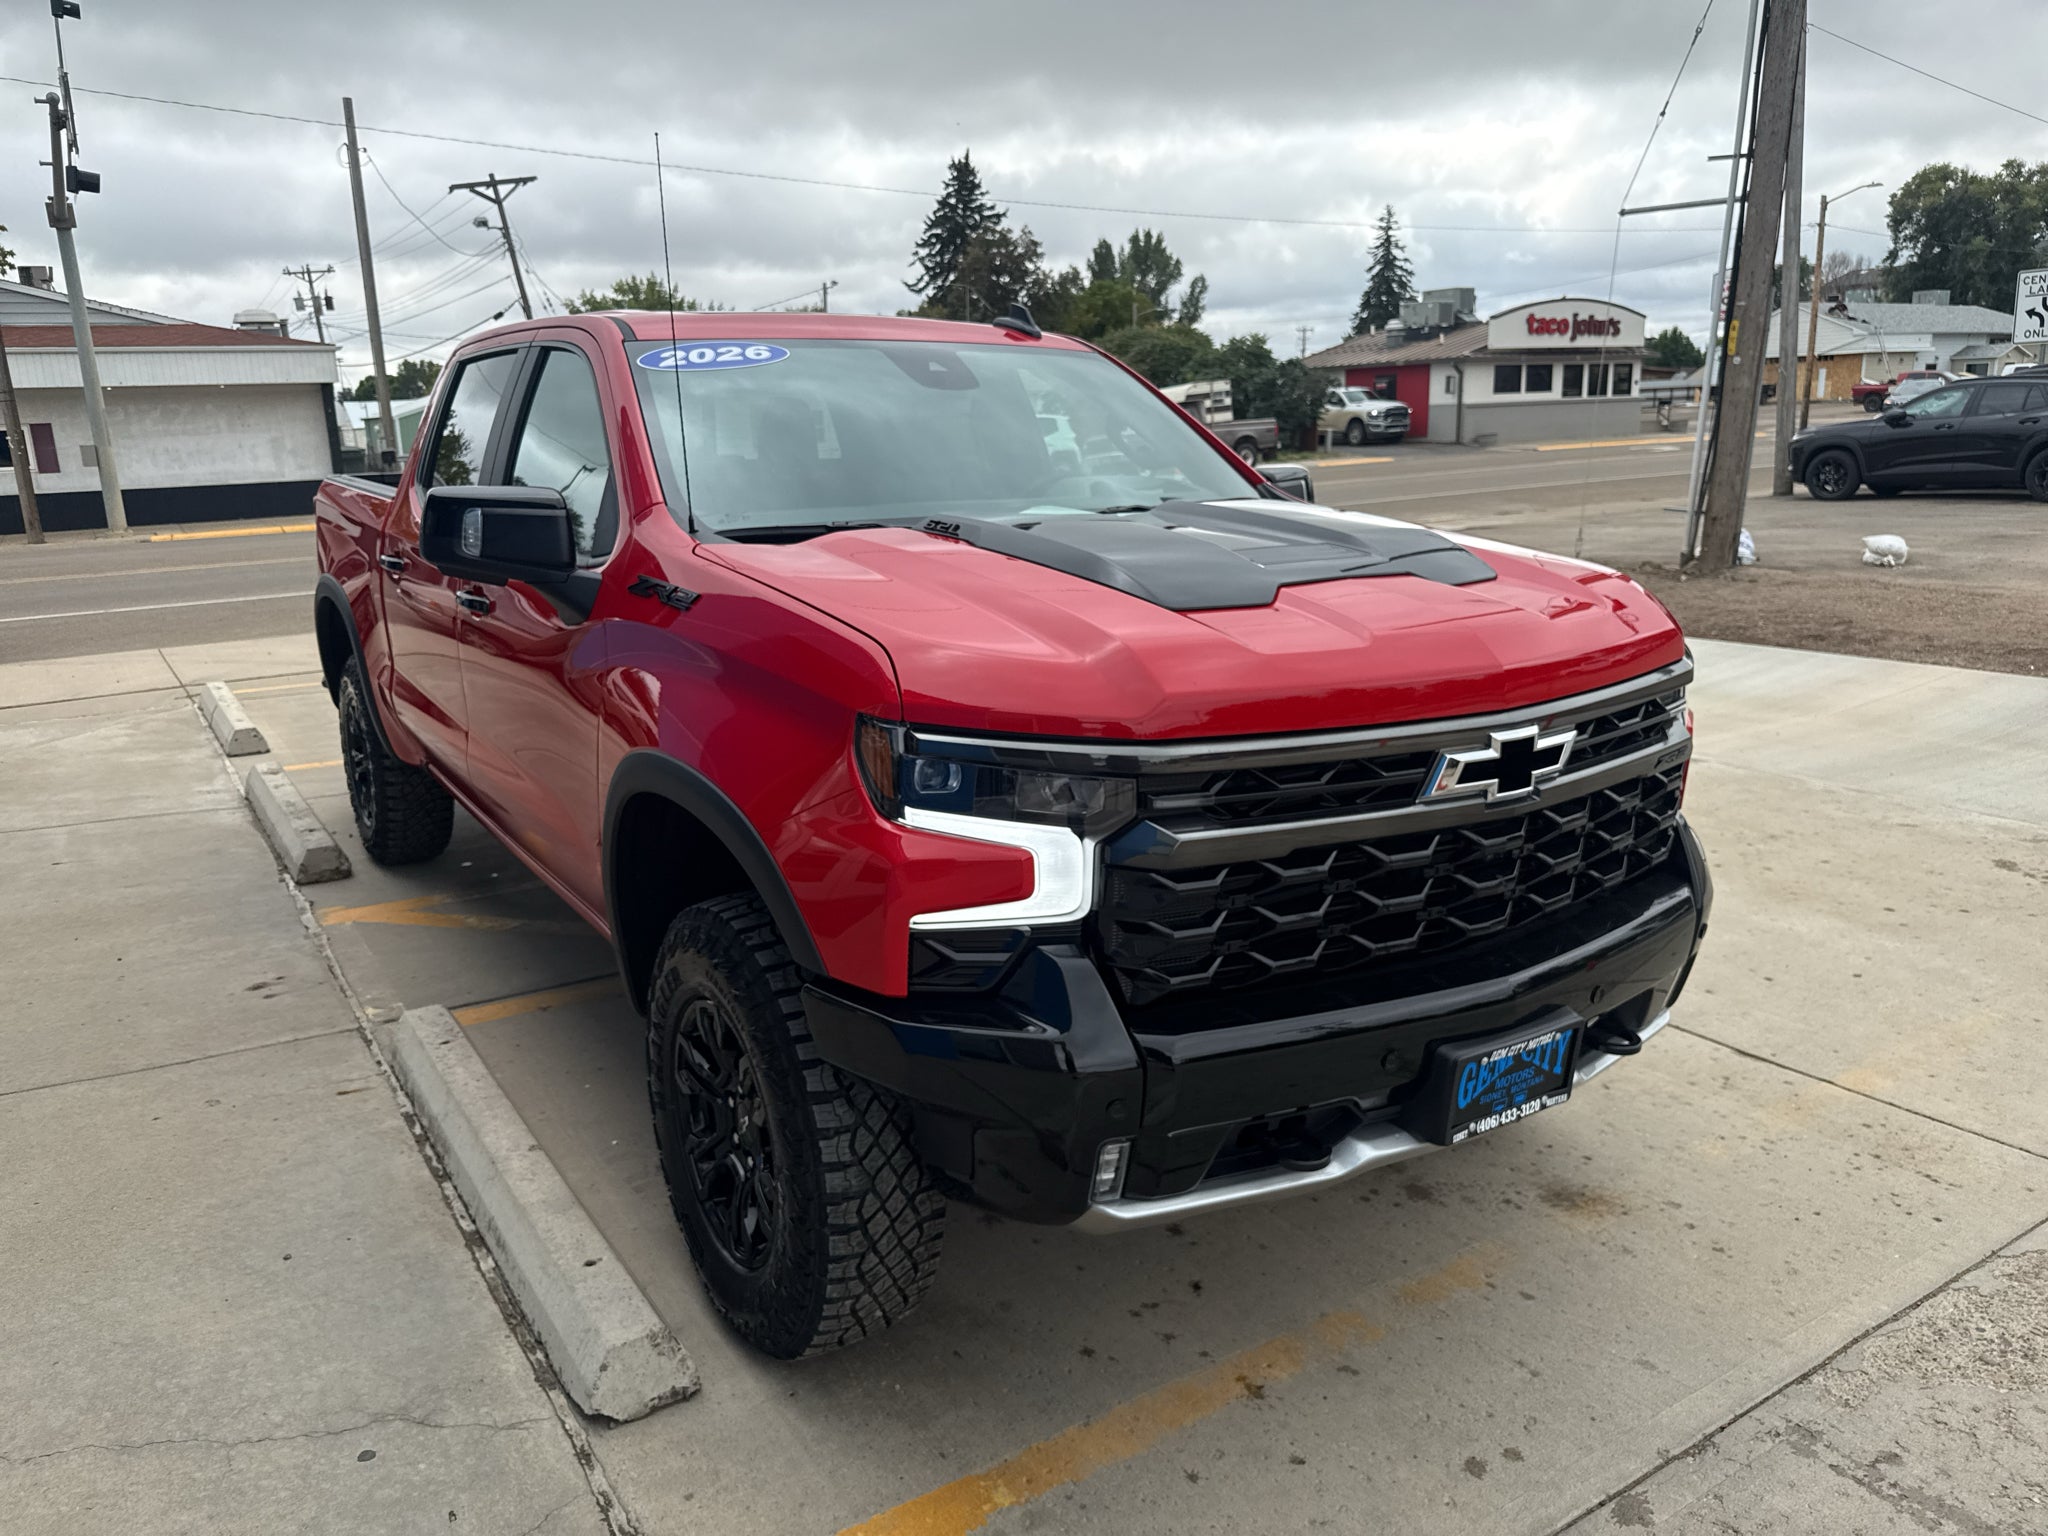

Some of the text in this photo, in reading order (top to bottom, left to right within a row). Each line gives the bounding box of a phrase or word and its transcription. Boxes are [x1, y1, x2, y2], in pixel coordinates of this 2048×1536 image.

[1526, 313, 1620, 342] taco john's
[659, 346, 772, 367] 2026
[628, 574, 702, 612] ZR2
[1508, 1041, 1527, 1056] CITY
[1526, 1031, 1556, 1051] MOTORS
[1457, 1029, 1573, 1109] GEM CITY
[1495, 1066, 1535, 1089] MOTORS
